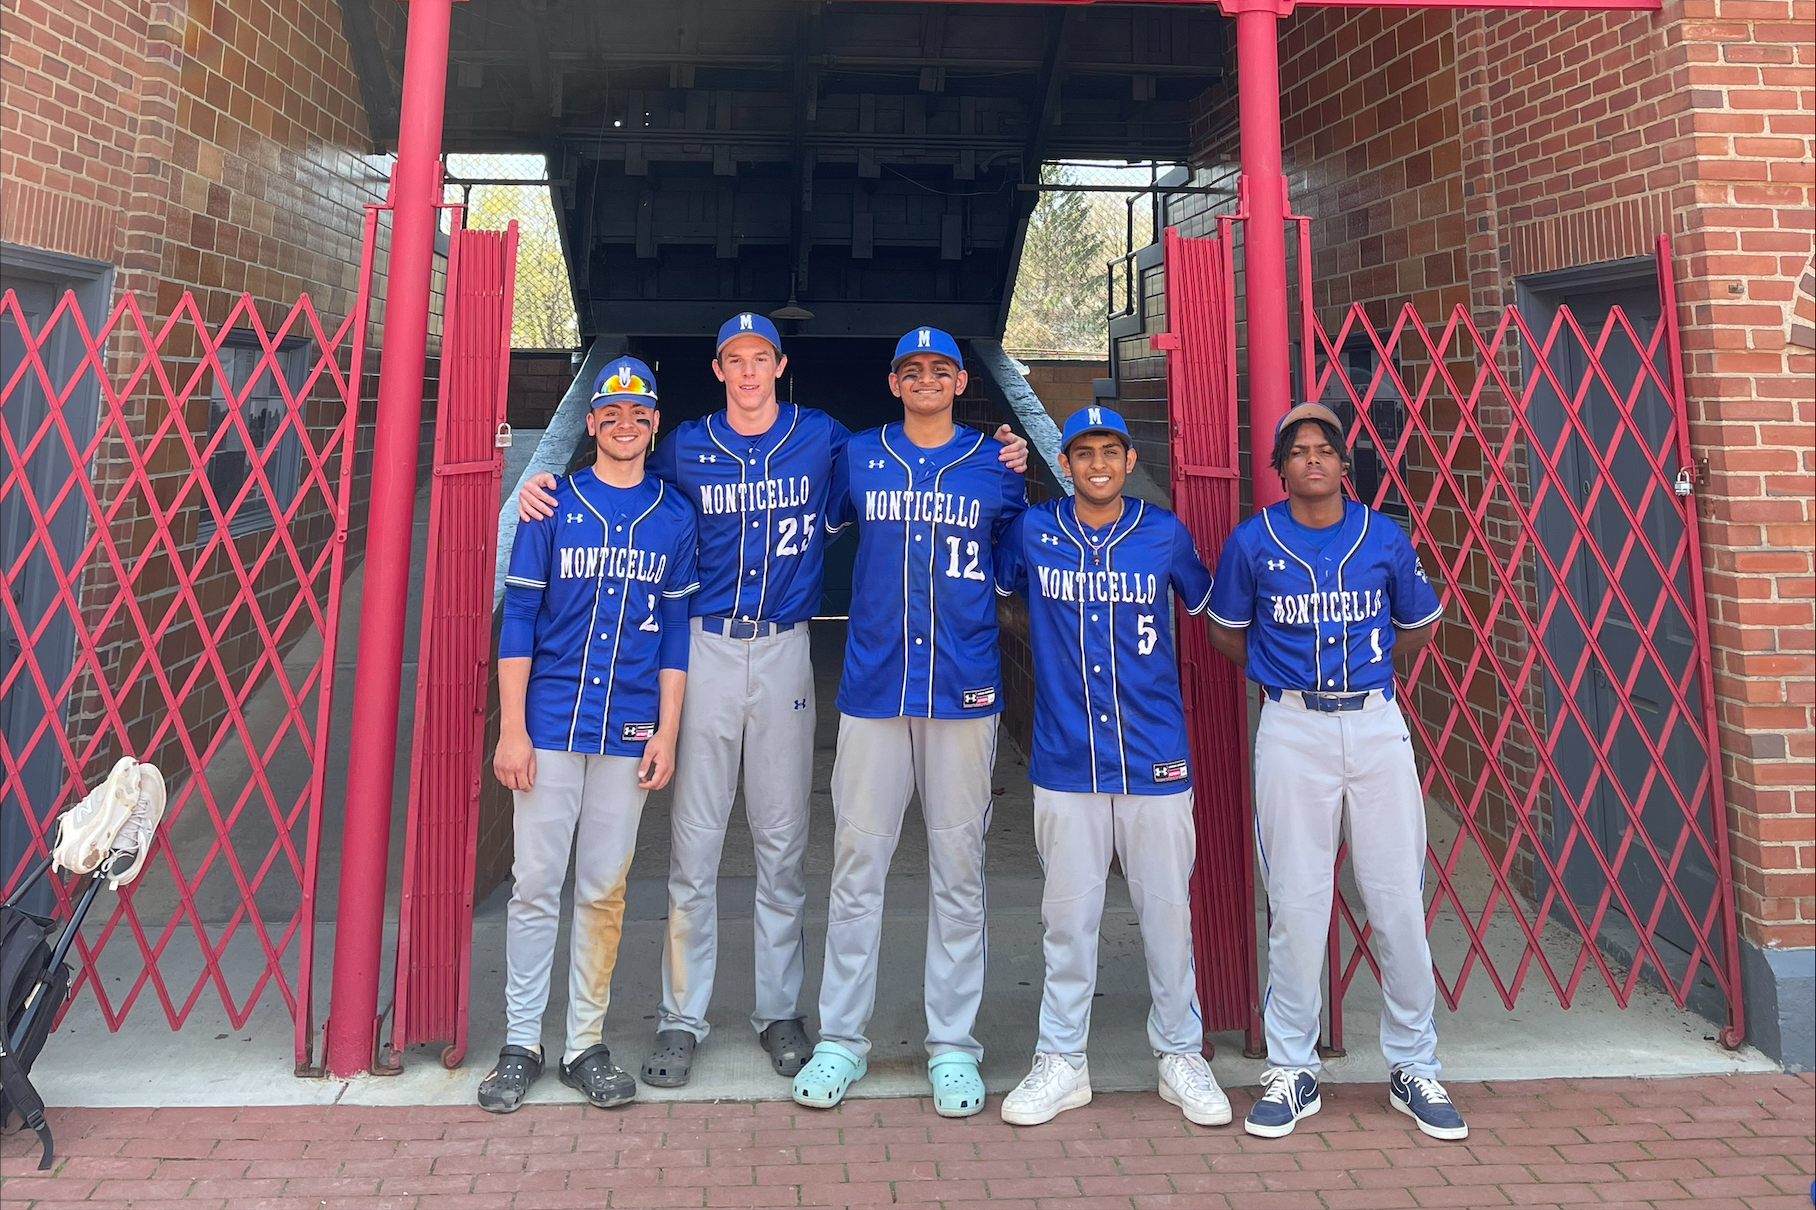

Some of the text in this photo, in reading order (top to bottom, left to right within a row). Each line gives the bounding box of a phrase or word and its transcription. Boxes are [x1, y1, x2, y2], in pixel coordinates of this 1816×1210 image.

[740, 314, 753, 330] M
[917, 330, 931, 348] M
[1087, 407, 1103, 425] M
[700, 475, 810, 515] MONTICELLO
[865, 490, 980, 530] MONTICELLO
[776, 512, 817, 557] 25
[559, 546, 667, 584] MONTICELLO
[945, 535, 986, 582] 12
[1037, 565, 1157, 605] MONTICELLO
[639, 593, 659, 633] 2
[1137, 613, 1158, 656] 5
